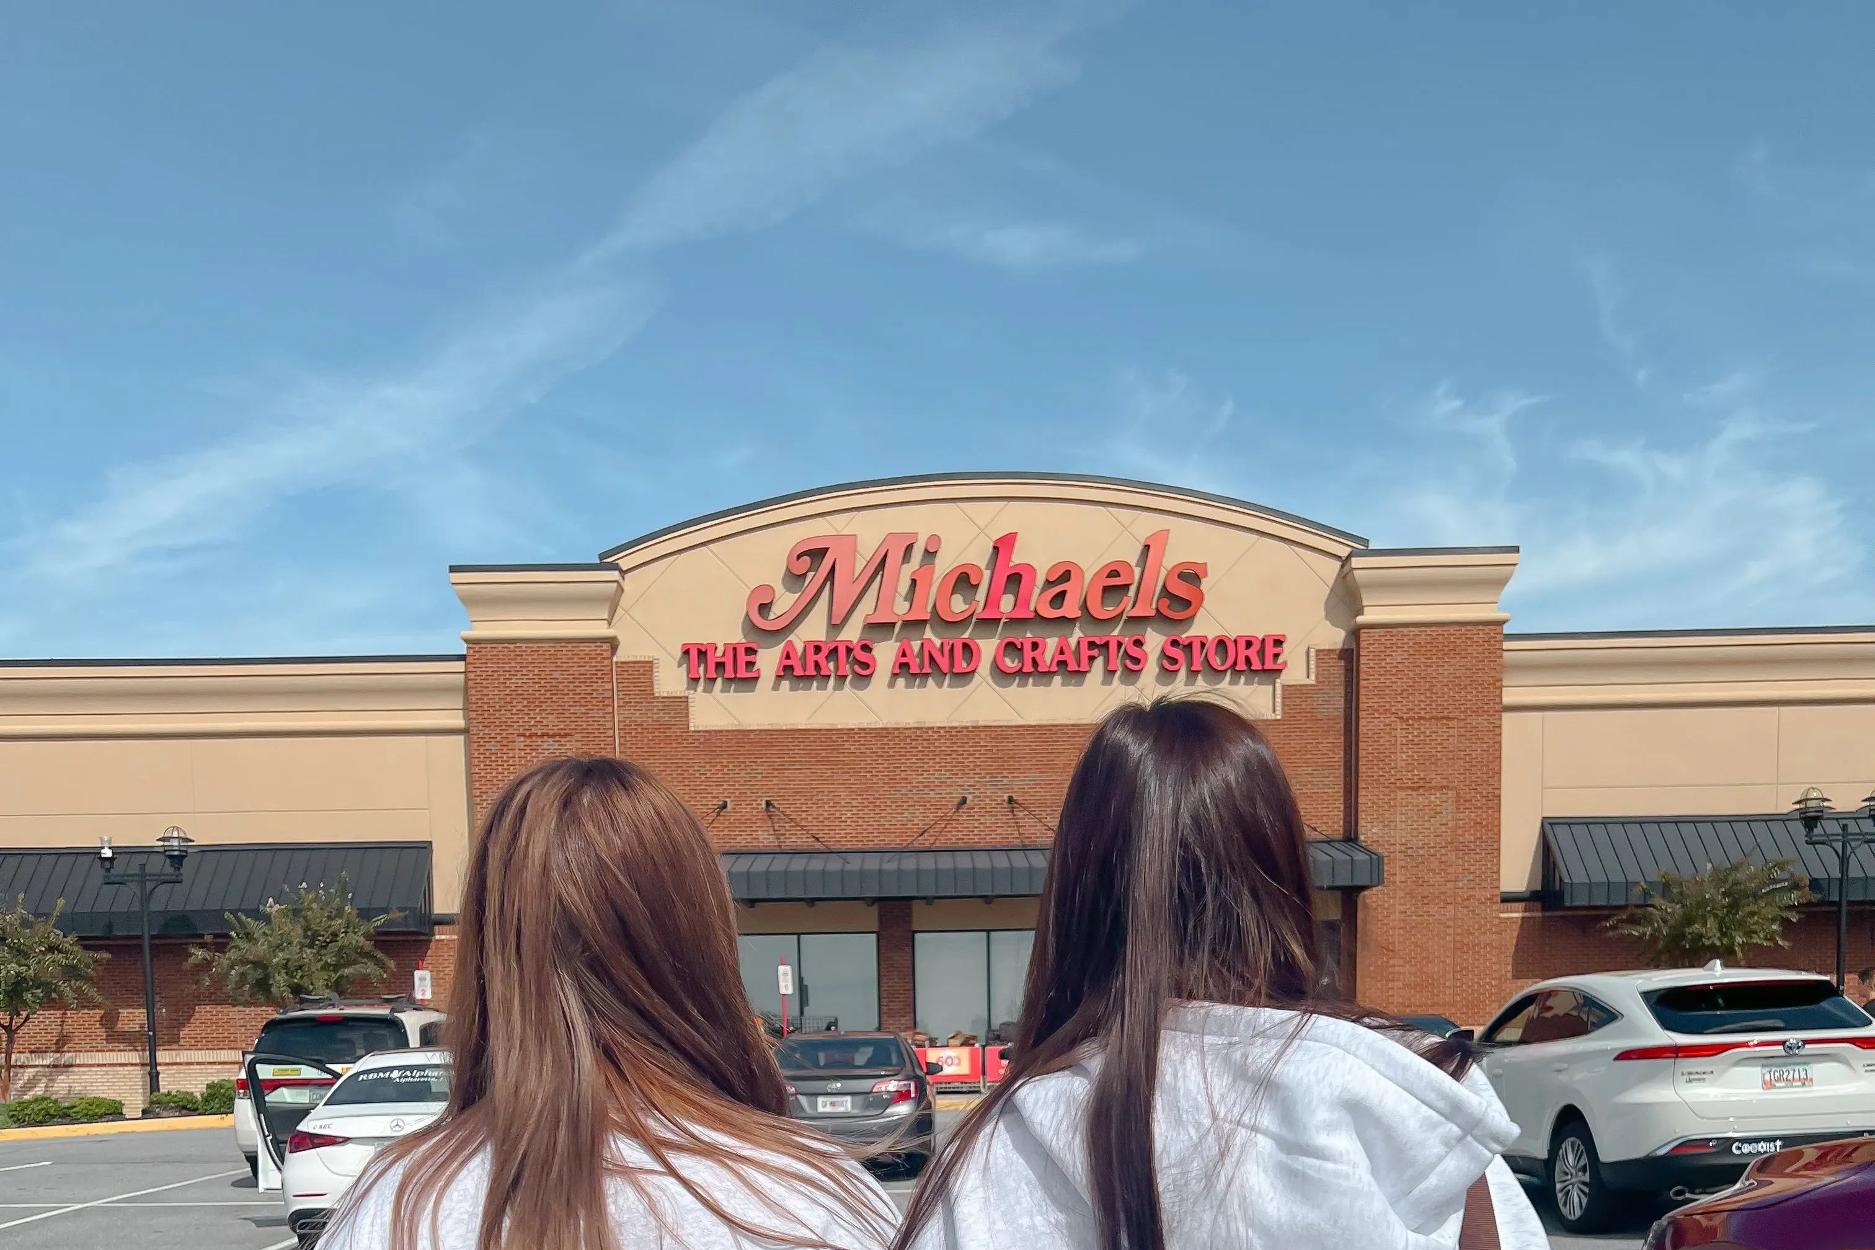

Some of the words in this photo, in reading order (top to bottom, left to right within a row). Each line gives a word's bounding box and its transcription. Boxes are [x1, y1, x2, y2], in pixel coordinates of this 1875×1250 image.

[747, 529, 1208, 631] Michaels
[681, 641, 761, 681] THE
[775, 638, 877, 678] ARTS
[892, 636, 982, 676] AND
[994, 633, 1149, 675] CRAFTS
[1160, 633, 1288, 673] STORE
